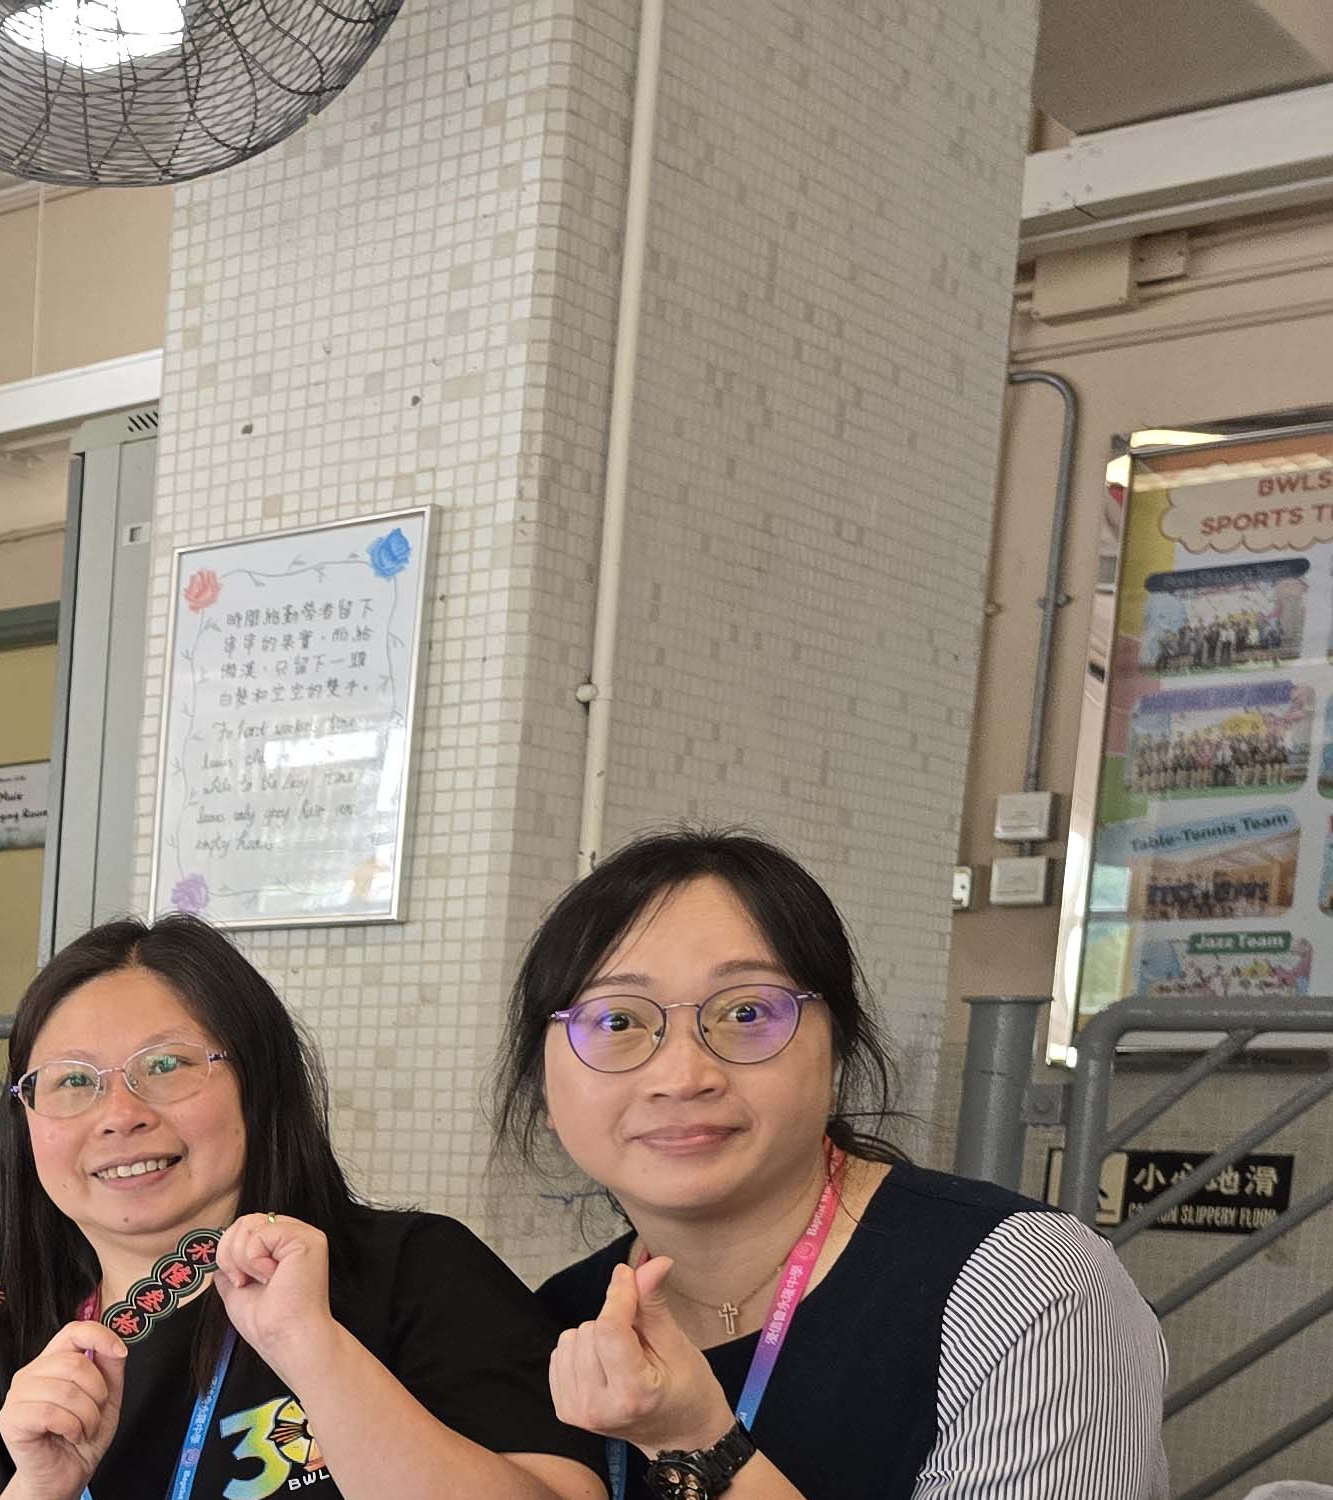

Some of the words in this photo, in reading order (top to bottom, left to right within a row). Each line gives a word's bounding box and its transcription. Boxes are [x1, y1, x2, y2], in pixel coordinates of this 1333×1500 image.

[1200, 506, 1304, 535] SPORTS
[1311, 503, 1333, 522] T
[1240, 812, 1289, 831] Team
[1237, 933, 1285, 949] Team
[1180, 1203, 1237, 1227] SLIPPERY
